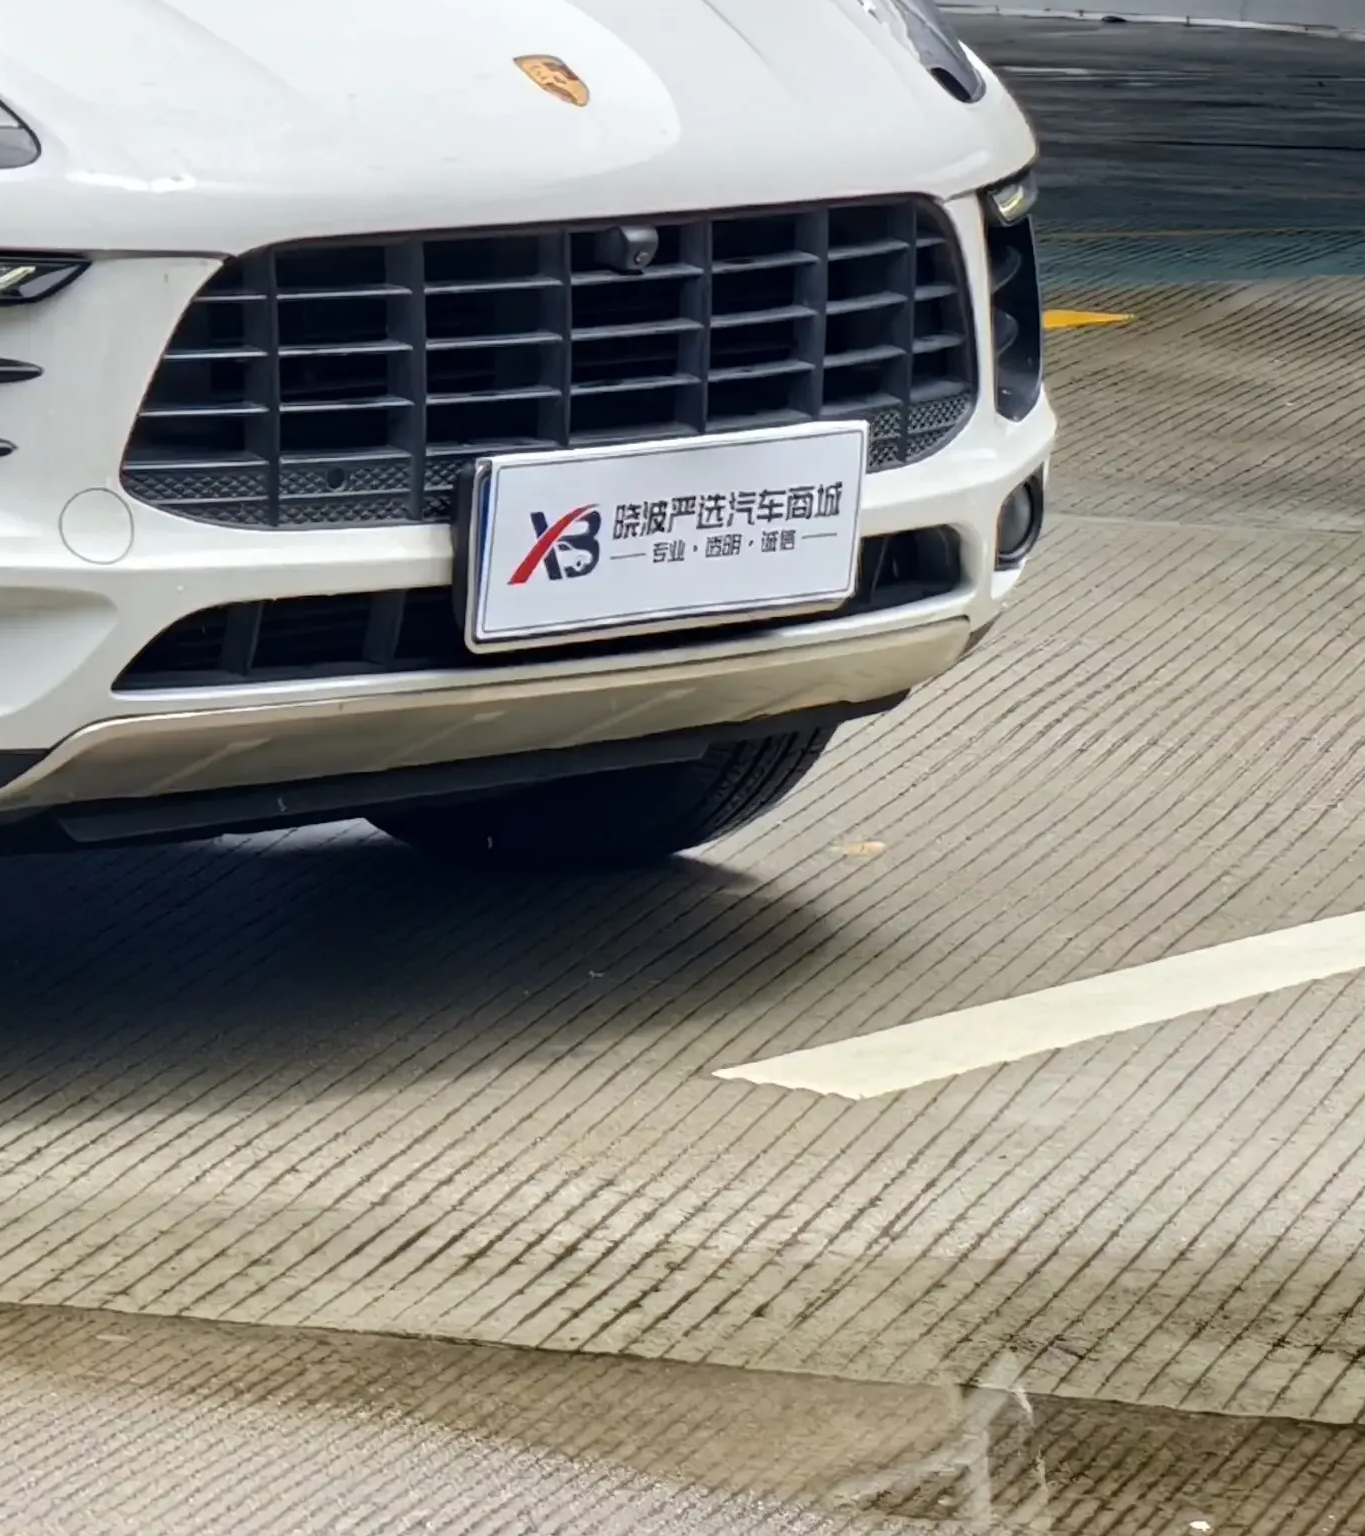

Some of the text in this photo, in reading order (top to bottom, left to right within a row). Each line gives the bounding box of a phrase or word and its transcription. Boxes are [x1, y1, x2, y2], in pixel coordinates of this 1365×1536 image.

[611, 481, 843, 540] 晓波严选汽车商城
